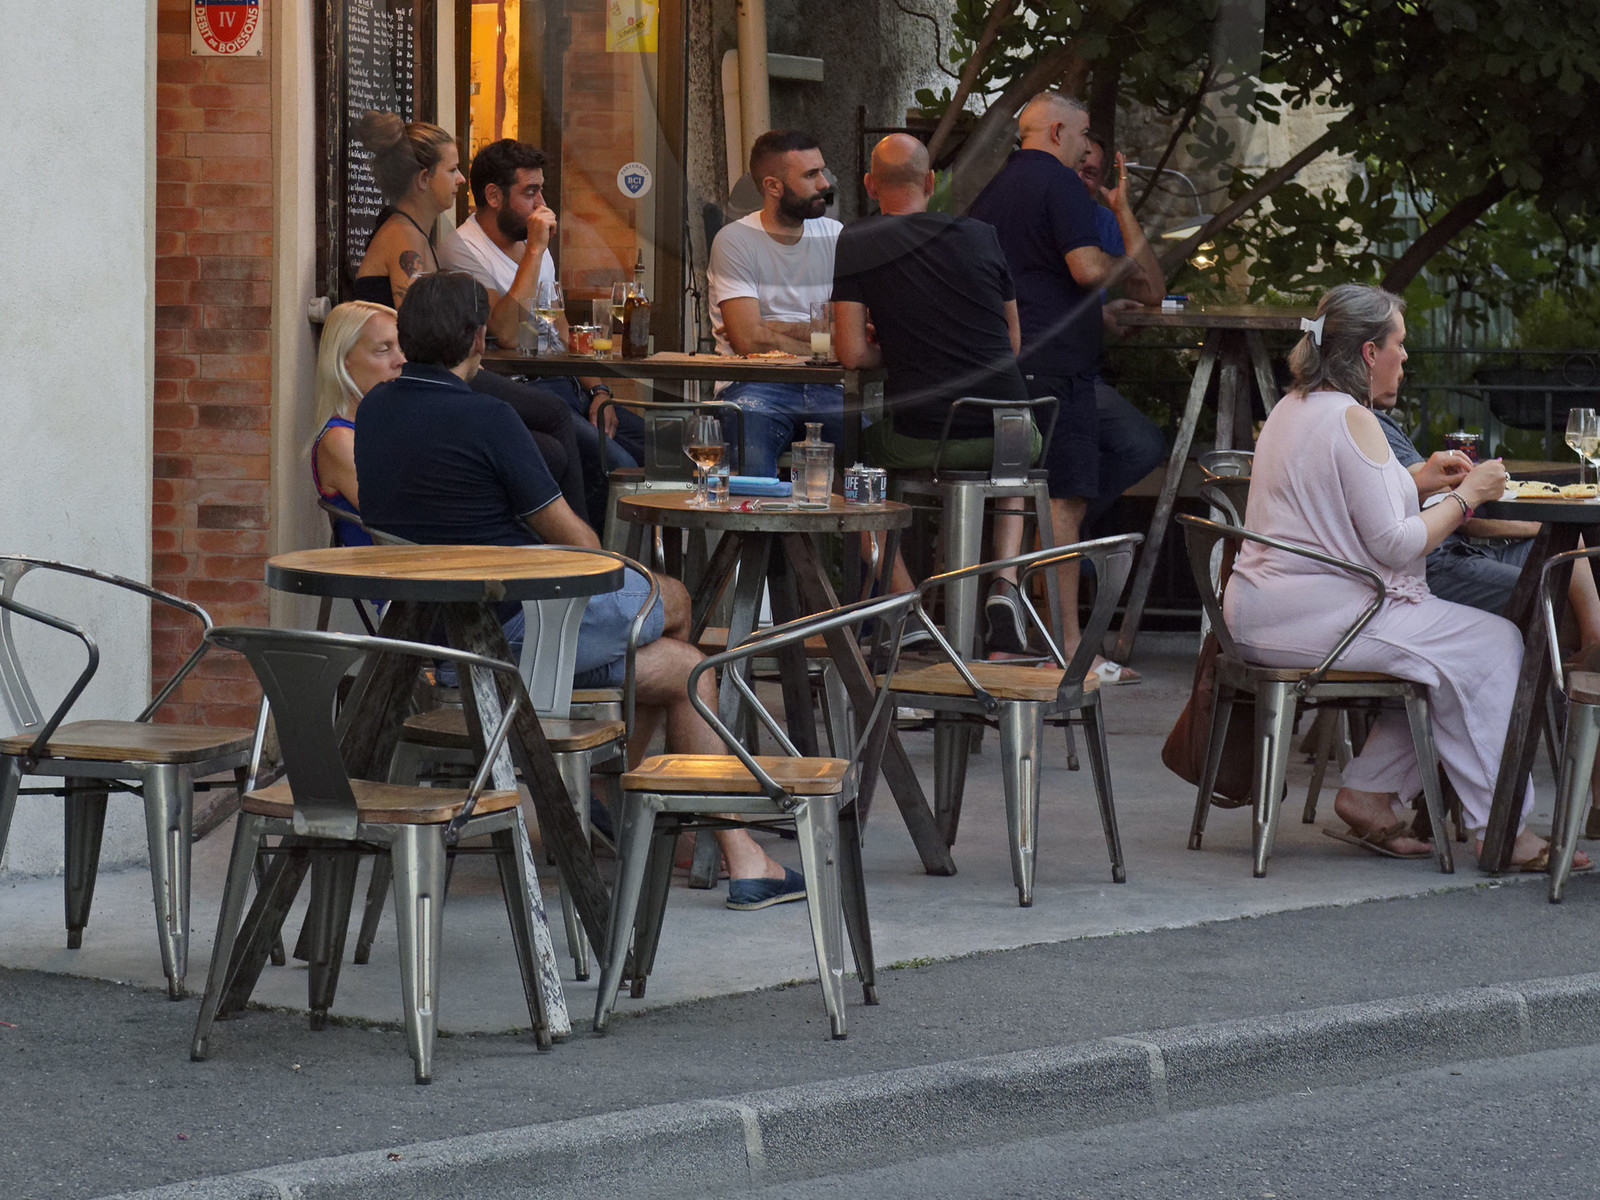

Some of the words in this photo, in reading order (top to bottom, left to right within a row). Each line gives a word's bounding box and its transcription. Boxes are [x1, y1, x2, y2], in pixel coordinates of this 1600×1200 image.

[196, 8, 212, 39] DEBIT
[218, 7, 258, 53] BOISSONS
[219, 11, 236, 28] IV
